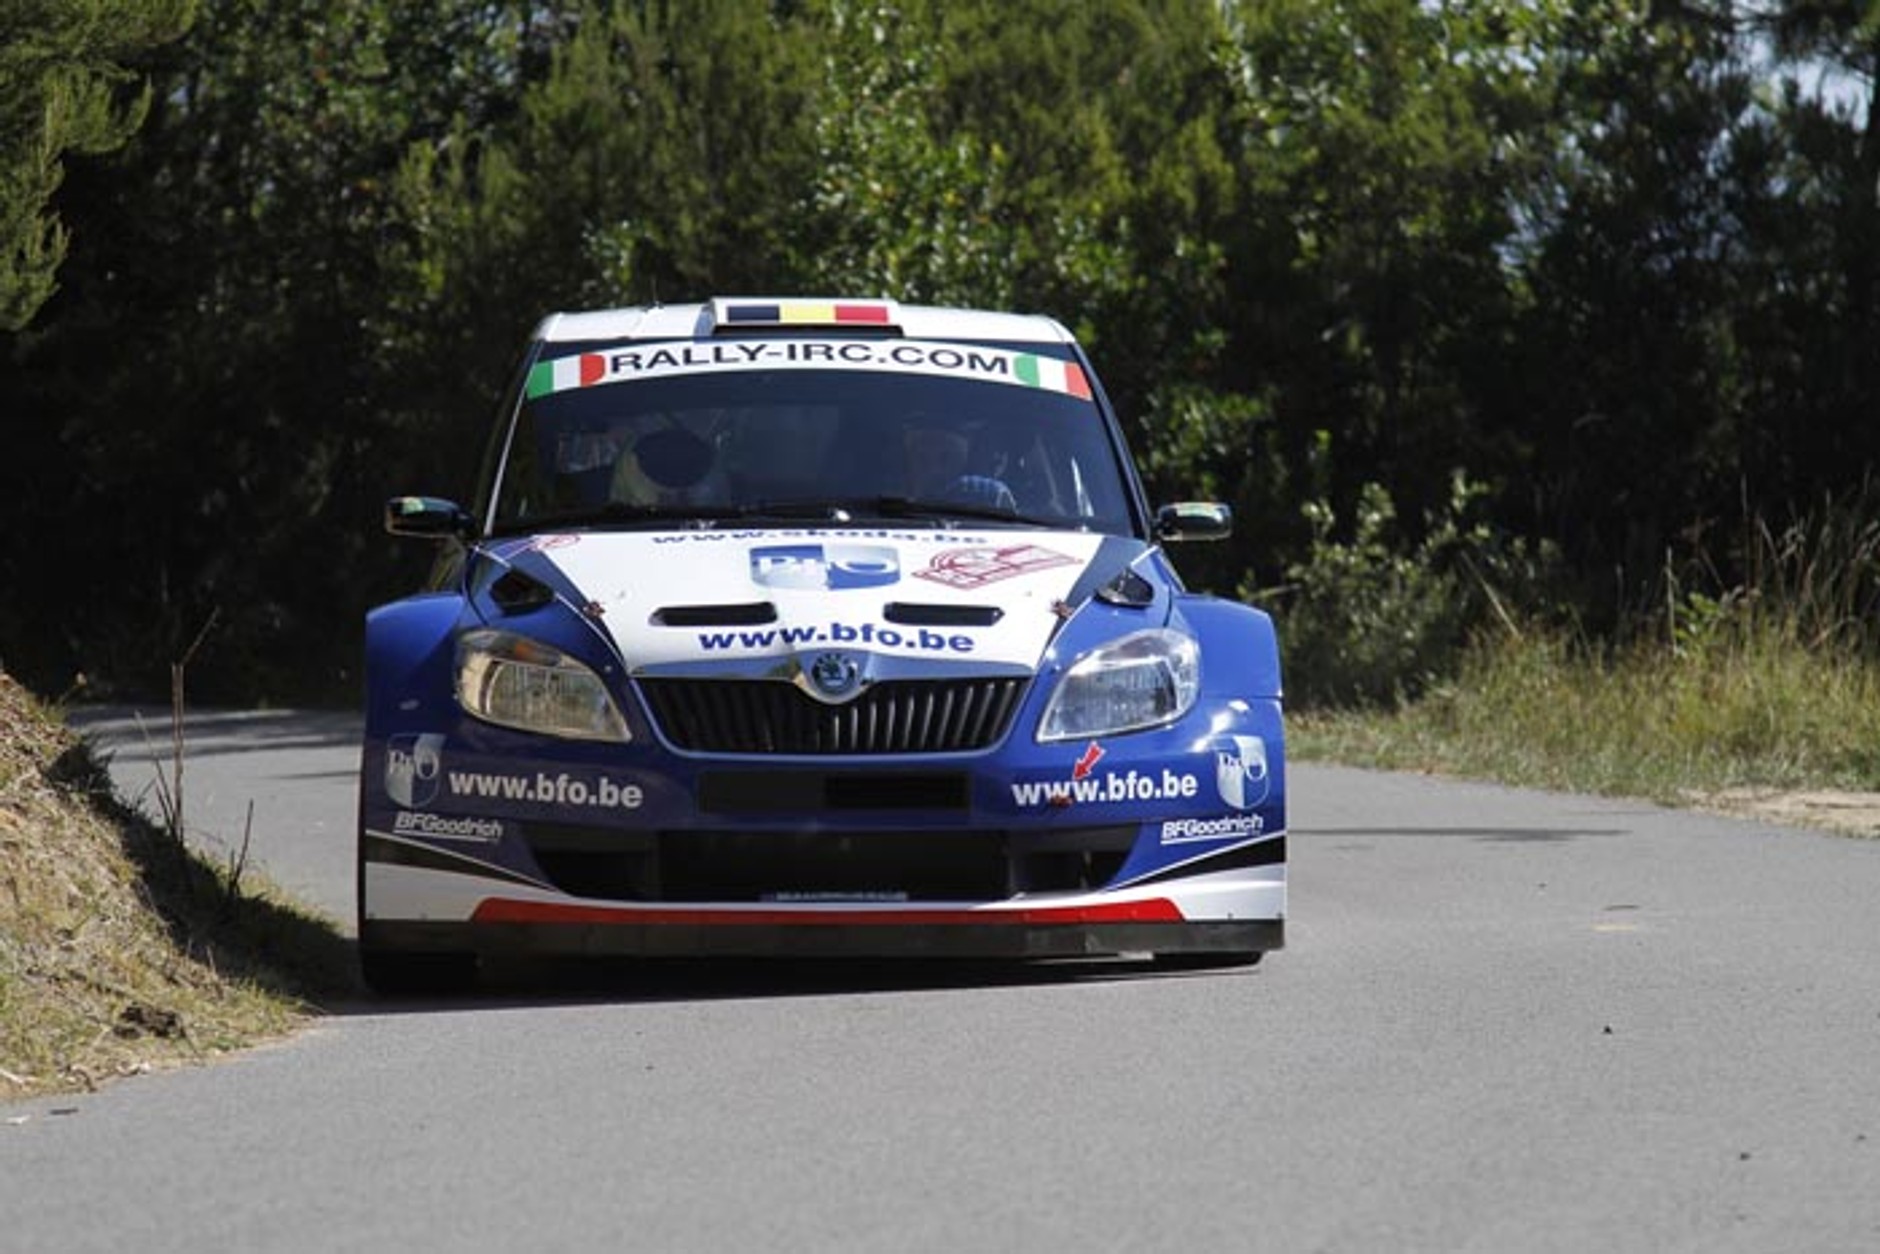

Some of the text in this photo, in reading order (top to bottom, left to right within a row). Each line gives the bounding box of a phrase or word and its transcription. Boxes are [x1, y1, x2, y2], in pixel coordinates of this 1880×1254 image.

[611, 342, 1008, 375] RALLY-IRC.COM
[699, 620, 975, 653] www.bfo.be
[448, 771, 644, 808] www.bfo.be
[1011, 769, 1197, 807] www.bfo.be
[394, 811, 504, 839] BFGoodrich
[1160, 813, 1264, 840] BFGoodrich
